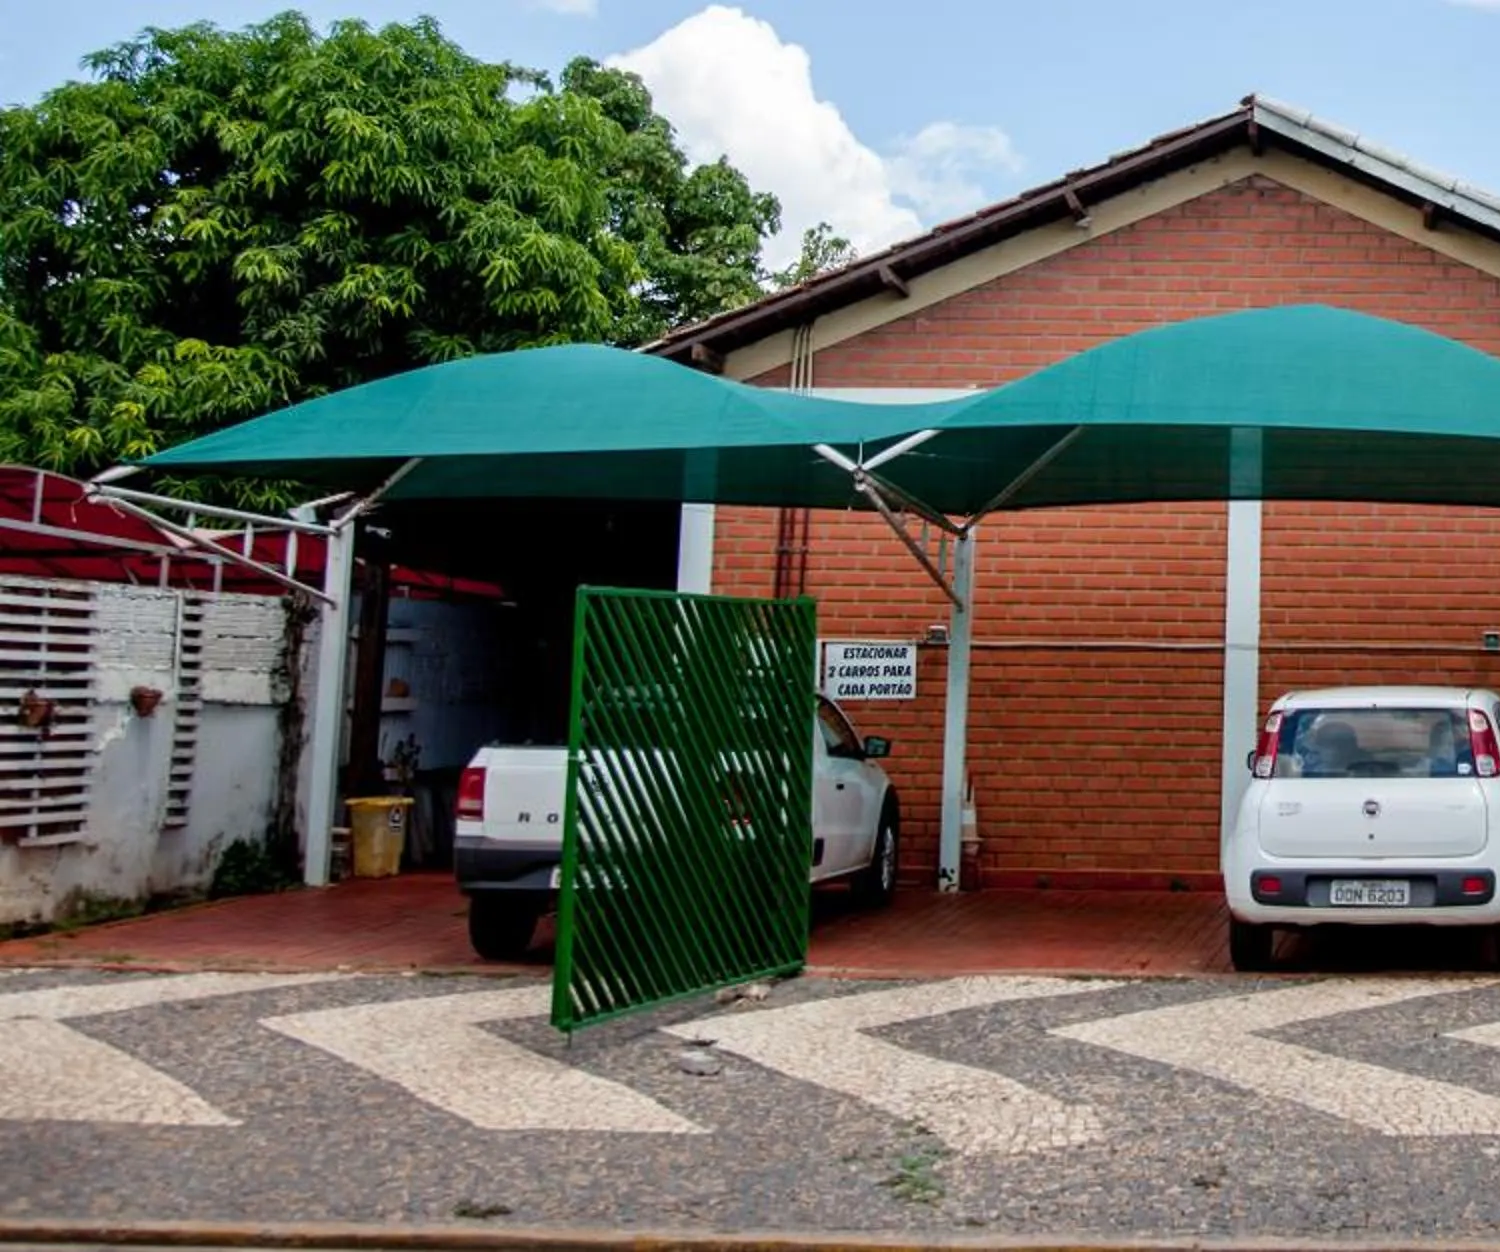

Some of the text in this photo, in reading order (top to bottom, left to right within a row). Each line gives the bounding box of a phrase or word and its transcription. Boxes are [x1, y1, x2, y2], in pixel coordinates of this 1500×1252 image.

[843, 647, 908, 659] ESTACIONAR
[828, 665, 912, 678] 2 CARROS PARA
[837, 683, 865, 696] CADA
